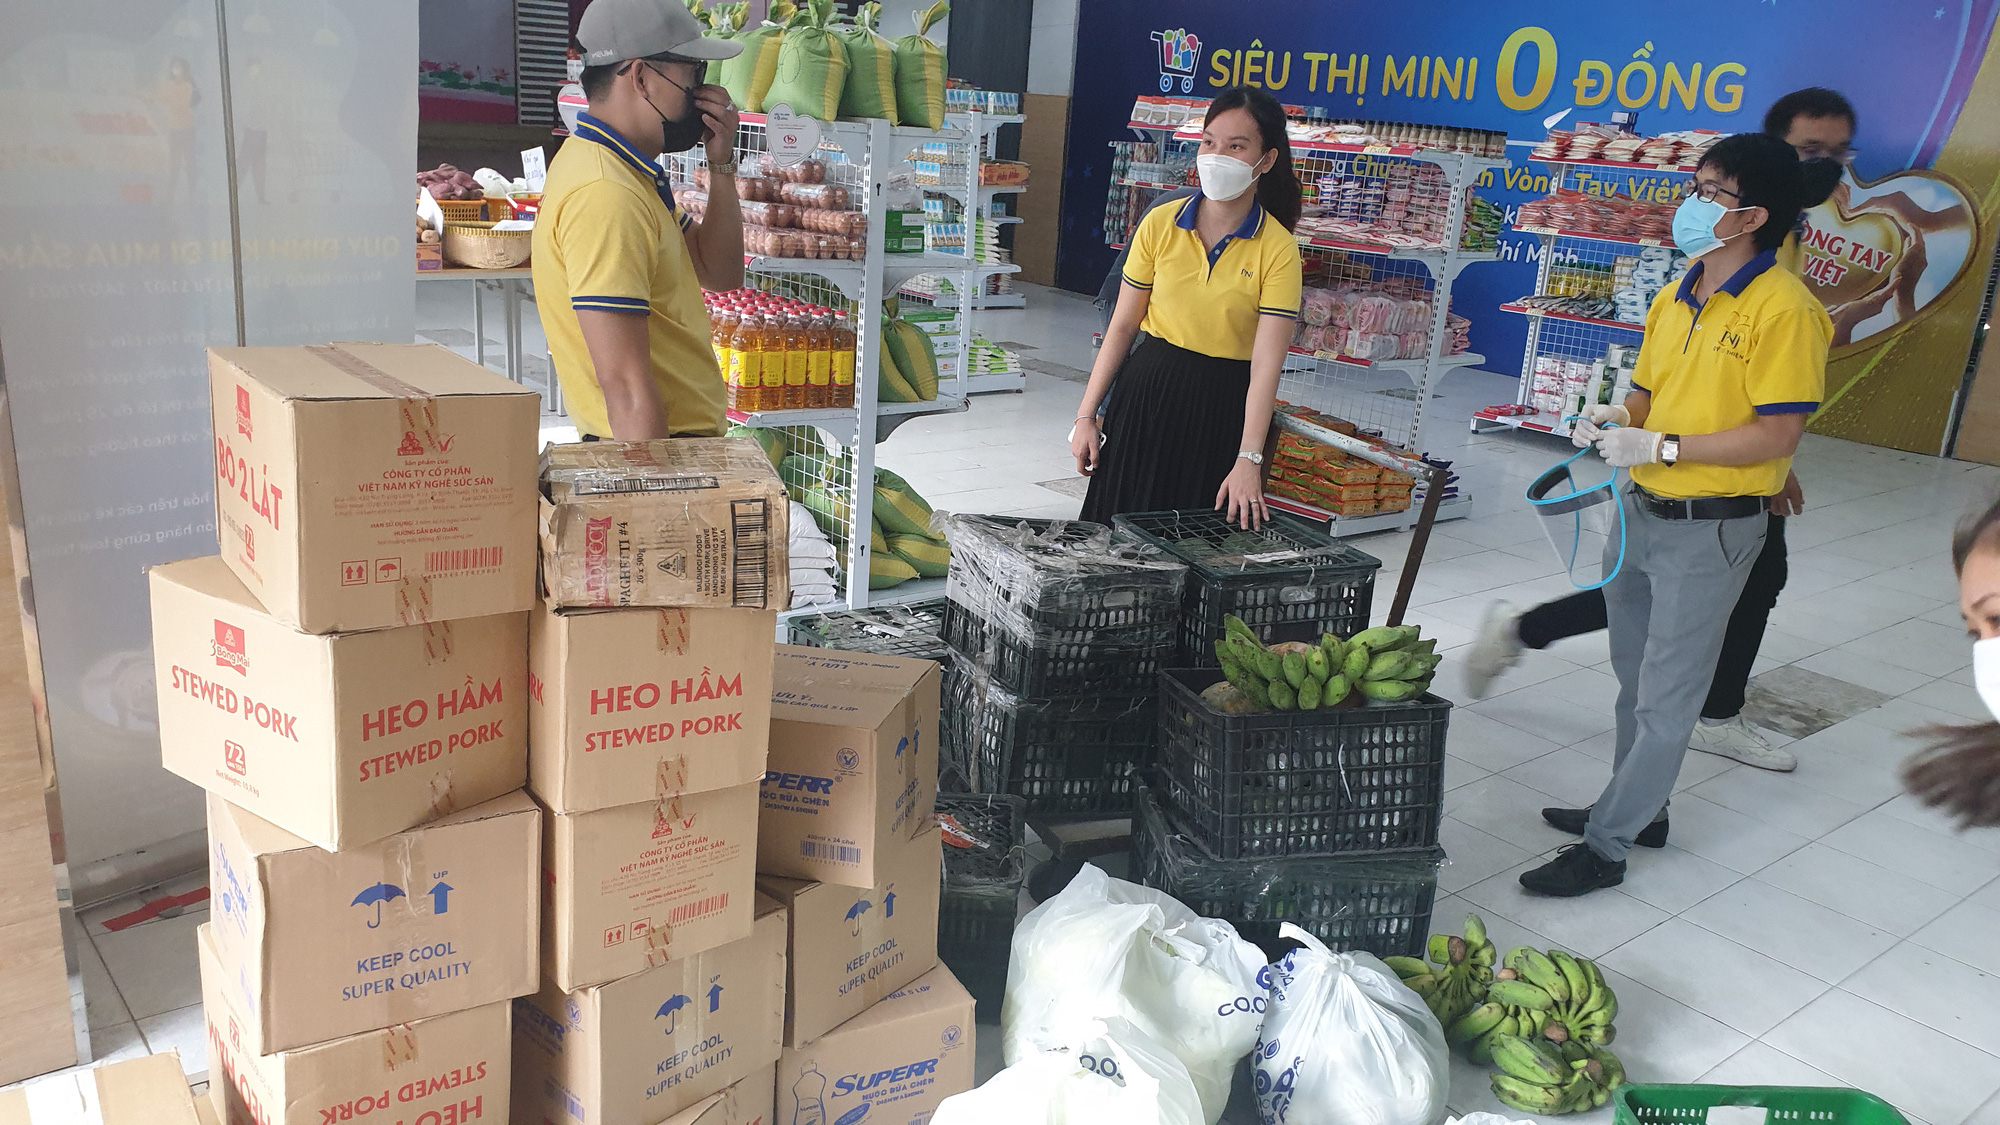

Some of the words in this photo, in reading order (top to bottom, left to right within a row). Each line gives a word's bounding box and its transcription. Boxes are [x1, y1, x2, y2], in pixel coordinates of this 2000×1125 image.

[1208, 38, 1291, 91] SIÊU
[1303, 52, 1370, 106] THỊ
[1381, 54, 1478, 101] MINI
[1495, 26, 1558, 111] 0
[1572, 40, 1747, 112] ĐỒNG
[1503, 166, 1553, 194] Vòn
[1803, 253, 1848, 287] VIỆT
[1848, 241, 1893, 273] TAY
[358, 482, 379, 493] VIỆT
[383, 481, 407, 491] NAM
[382, 468, 412, 480] CÔNG
[413, 469, 426, 478] TY
[238, 457, 248, 503] 2
[250, 463, 283, 531] LÁT
[617, 521, 629, 536] #4
[703, 528, 711, 548] DRIVE
[636, 547, 646, 567] 500g
[719, 528, 727, 566] AUSTRALIA
[695, 558, 703, 592] BALDUCCI
[210, 638, 216, 657] 3
[216, 645, 237, 665] Bông
[237, 654, 250, 668] Mai
[172, 664, 238, 714] STEWED
[243, 695, 299, 742] PORK
[590, 682, 661, 715] HEO
[670, 665, 743, 705] HẦM
[362, 699, 428, 742] HEO
[437, 674, 503, 721] HẦM
[584, 722, 675, 752] STEWED
[681, 712, 743, 738] PORK
[226, 741, 244, 765] 72
[359, 739, 443, 782] STEWED
[448, 719, 504, 754] PORK
[761, 770, 834, 794] PERR
[764, 802, 819, 815] DISHWASHING
[639, 848, 663, 859] CÔNG
[663, 845, 674, 853] TY
[842, 838, 856, 846] chai
[433, 870, 449, 880] UP
[639, 858, 659, 869] NAM
[886, 882, 895, 891] UP
[357, 951, 404, 974] KEEP
[408, 941, 457, 963] COOL
[846, 951, 871, 974] KEEP
[872, 938, 898, 959] COOL
[342, 977, 395, 1002] SUPER
[400, 960, 472, 990] QUALITY
[710, 974, 721, 984] UP
[838, 972, 866, 998] SUPER
[867, 950, 905, 980] QUALITY
[656, 1049, 689, 1075] KEEP
[691, 1033, 724, 1057] COOL
[397, 1060, 488, 1102] STEWED
[646, 1072, 682, 1101] SUPER
[684, 1045, 734, 1080] QUALITY
[830, 1058, 939, 1099] SUPERR
[319, 1090, 390, 1125] PORK
[875, 1088, 925, 1106] DISHWASHING
